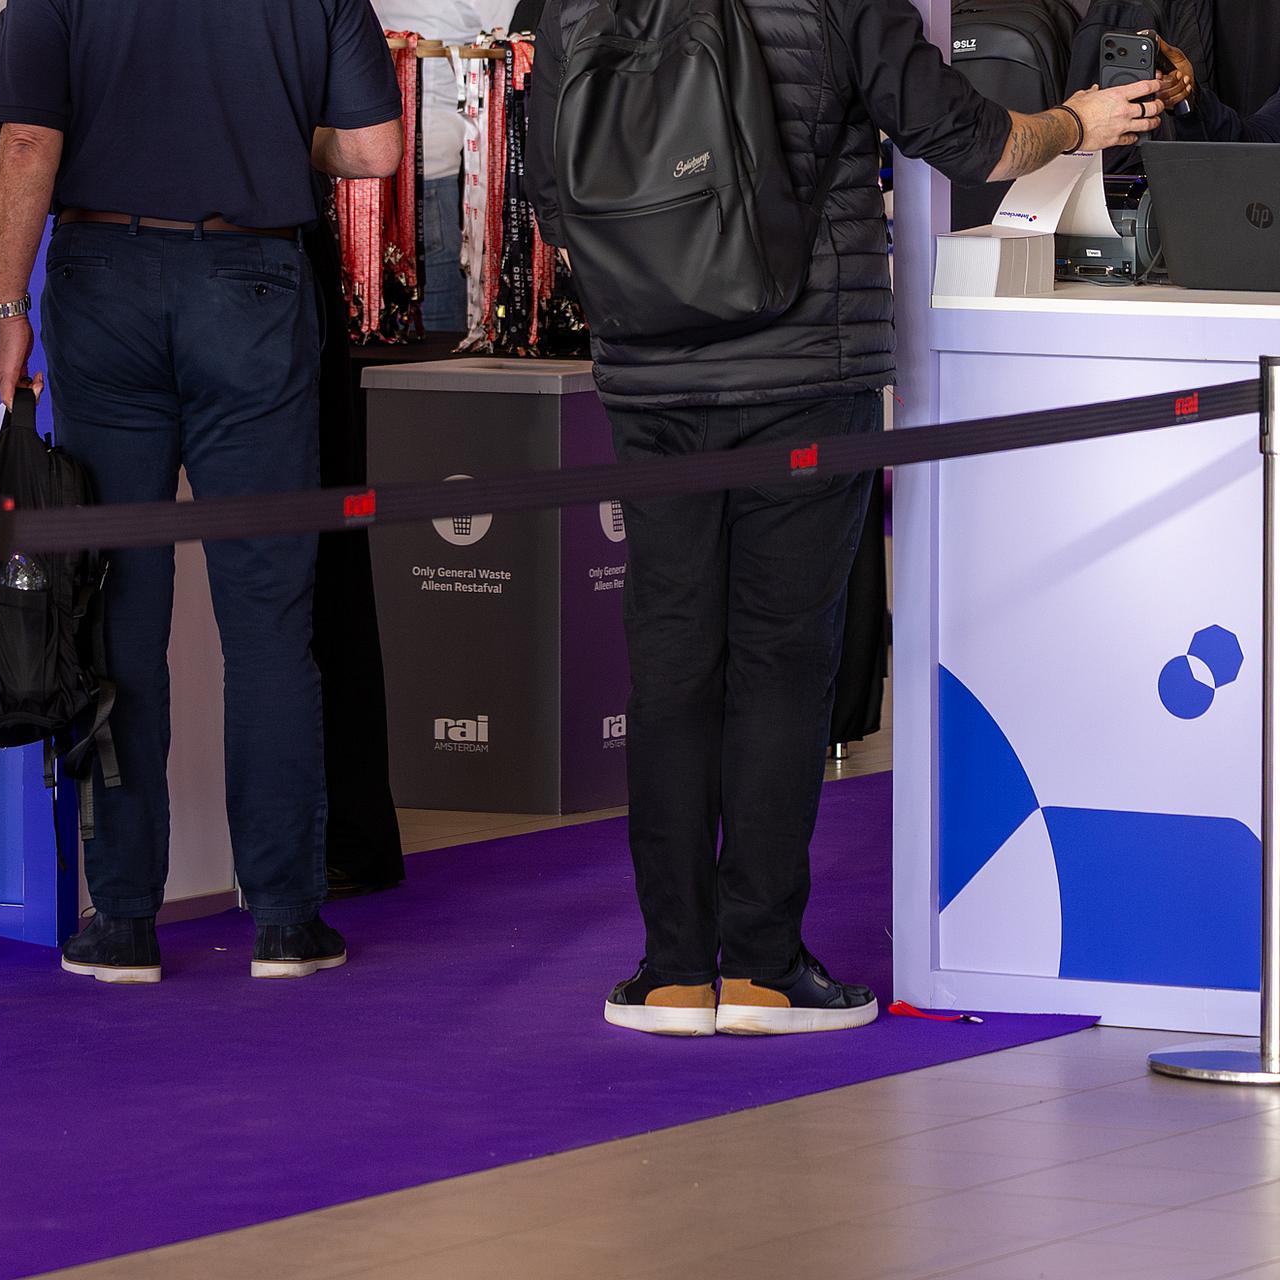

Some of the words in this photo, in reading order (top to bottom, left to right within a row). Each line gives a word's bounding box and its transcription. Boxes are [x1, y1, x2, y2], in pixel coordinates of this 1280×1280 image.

[960, 39, 977, 48] SLZ
[510, 198, 519, 241] NEXARO
[1175, 391, 1199, 416] rai
[412, 566, 436, 580] Only
[437, 567, 477, 579] General
[478, 569, 512, 580] Waste
[589, 567, 603, 580] Only
[421, 581, 453, 592] Alleen
[454, 582, 502, 594] Restafval
[594, 579, 613, 592] Alleen
[434, 715, 489, 742] rai
[603, 714, 626, 739] ra
[434, 741, 489, 753] AMSTERDAM
